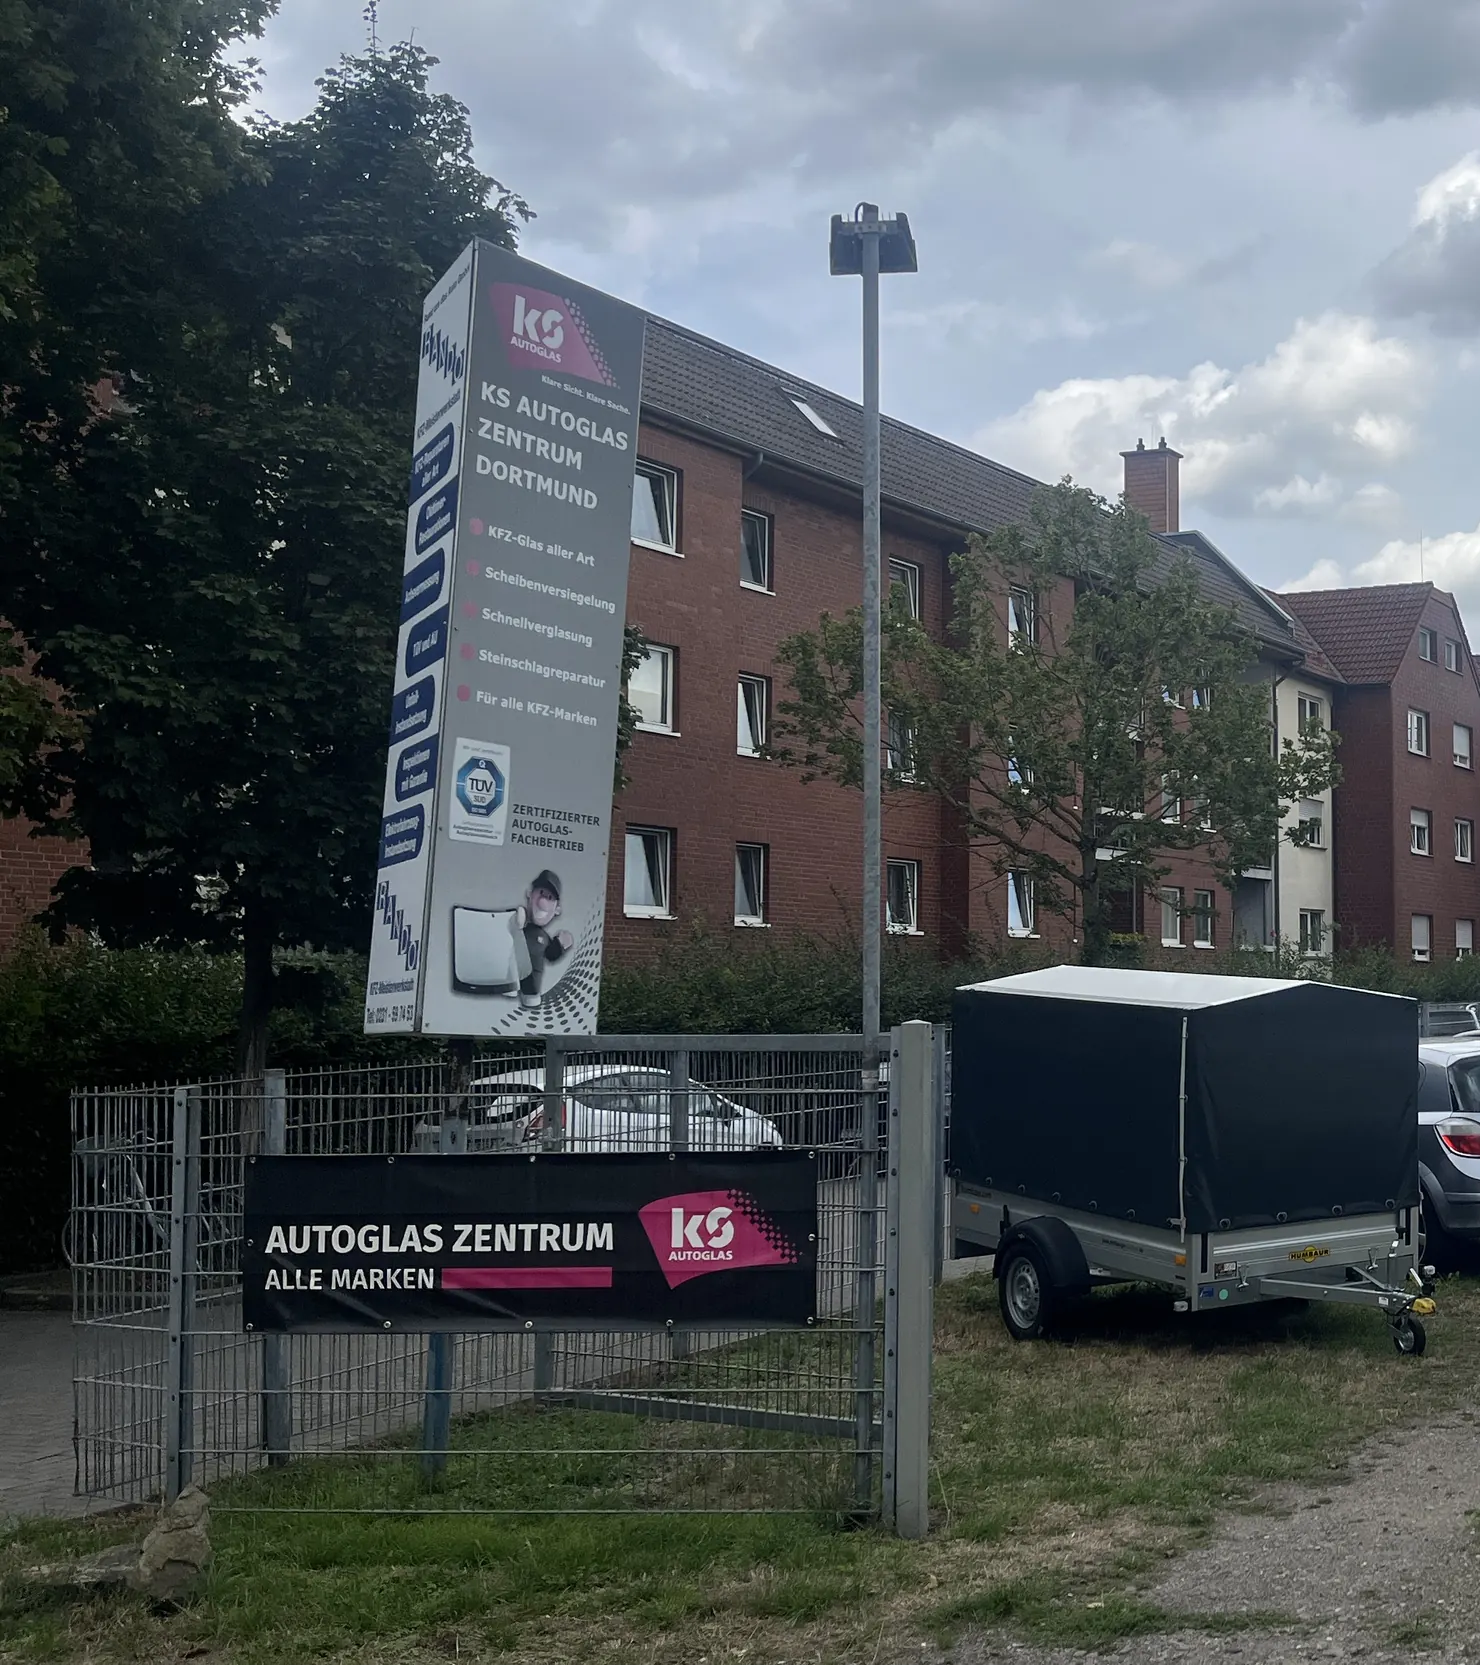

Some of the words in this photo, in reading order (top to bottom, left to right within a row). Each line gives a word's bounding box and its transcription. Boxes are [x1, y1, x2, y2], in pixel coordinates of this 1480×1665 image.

[510, 336, 562, 363] AUTOGLAS
[541, 374, 562, 390] Klare
[564, 382, 585, 398] Sicht.
[586, 391, 607, 406] Klare
[607, 400, 631, 416] Sache.
[481, 381, 511, 408] KS
[516, 396, 628, 450] AUTOGLAS
[478, 416, 582, 471] ZENTRUM
[476, 454, 598, 510] DORTMUND
[488, 525, 544, 552] KFZ-Glas
[546, 542, 574, 560] aller
[576, 550, 596, 567] Art
[485, 566, 616, 614] Scheibenversiegelung
[482, 608, 593, 648] Schnellverglasung
[478, 649, 606, 688] Steinschlagreparatur
[476, 690, 498, 706] Für
[500, 696, 524, 712] alle
[526, 701, 598, 727] KFZ-Marken
[468, 778, 494, 793] TÜV
[512, 803, 600, 827] ZERTIFIZIERTER
[512, 818, 573, 836] AUTOGLAS-
[511, 833, 584, 852] FACHBETRIEB
[376, 880, 420, 972] RANDO
[264, 1223, 443, 1254] AUTOGLAS
[452, 1222, 614, 1253] ZENTRUM
[668, 1249, 734, 1262] AUTOGLAS
[1290, 1248, 1330, 1260] HUMBAUR
[264, 1269, 322, 1292] ALLE
[330, 1267, 434, 1290] MARKEN
